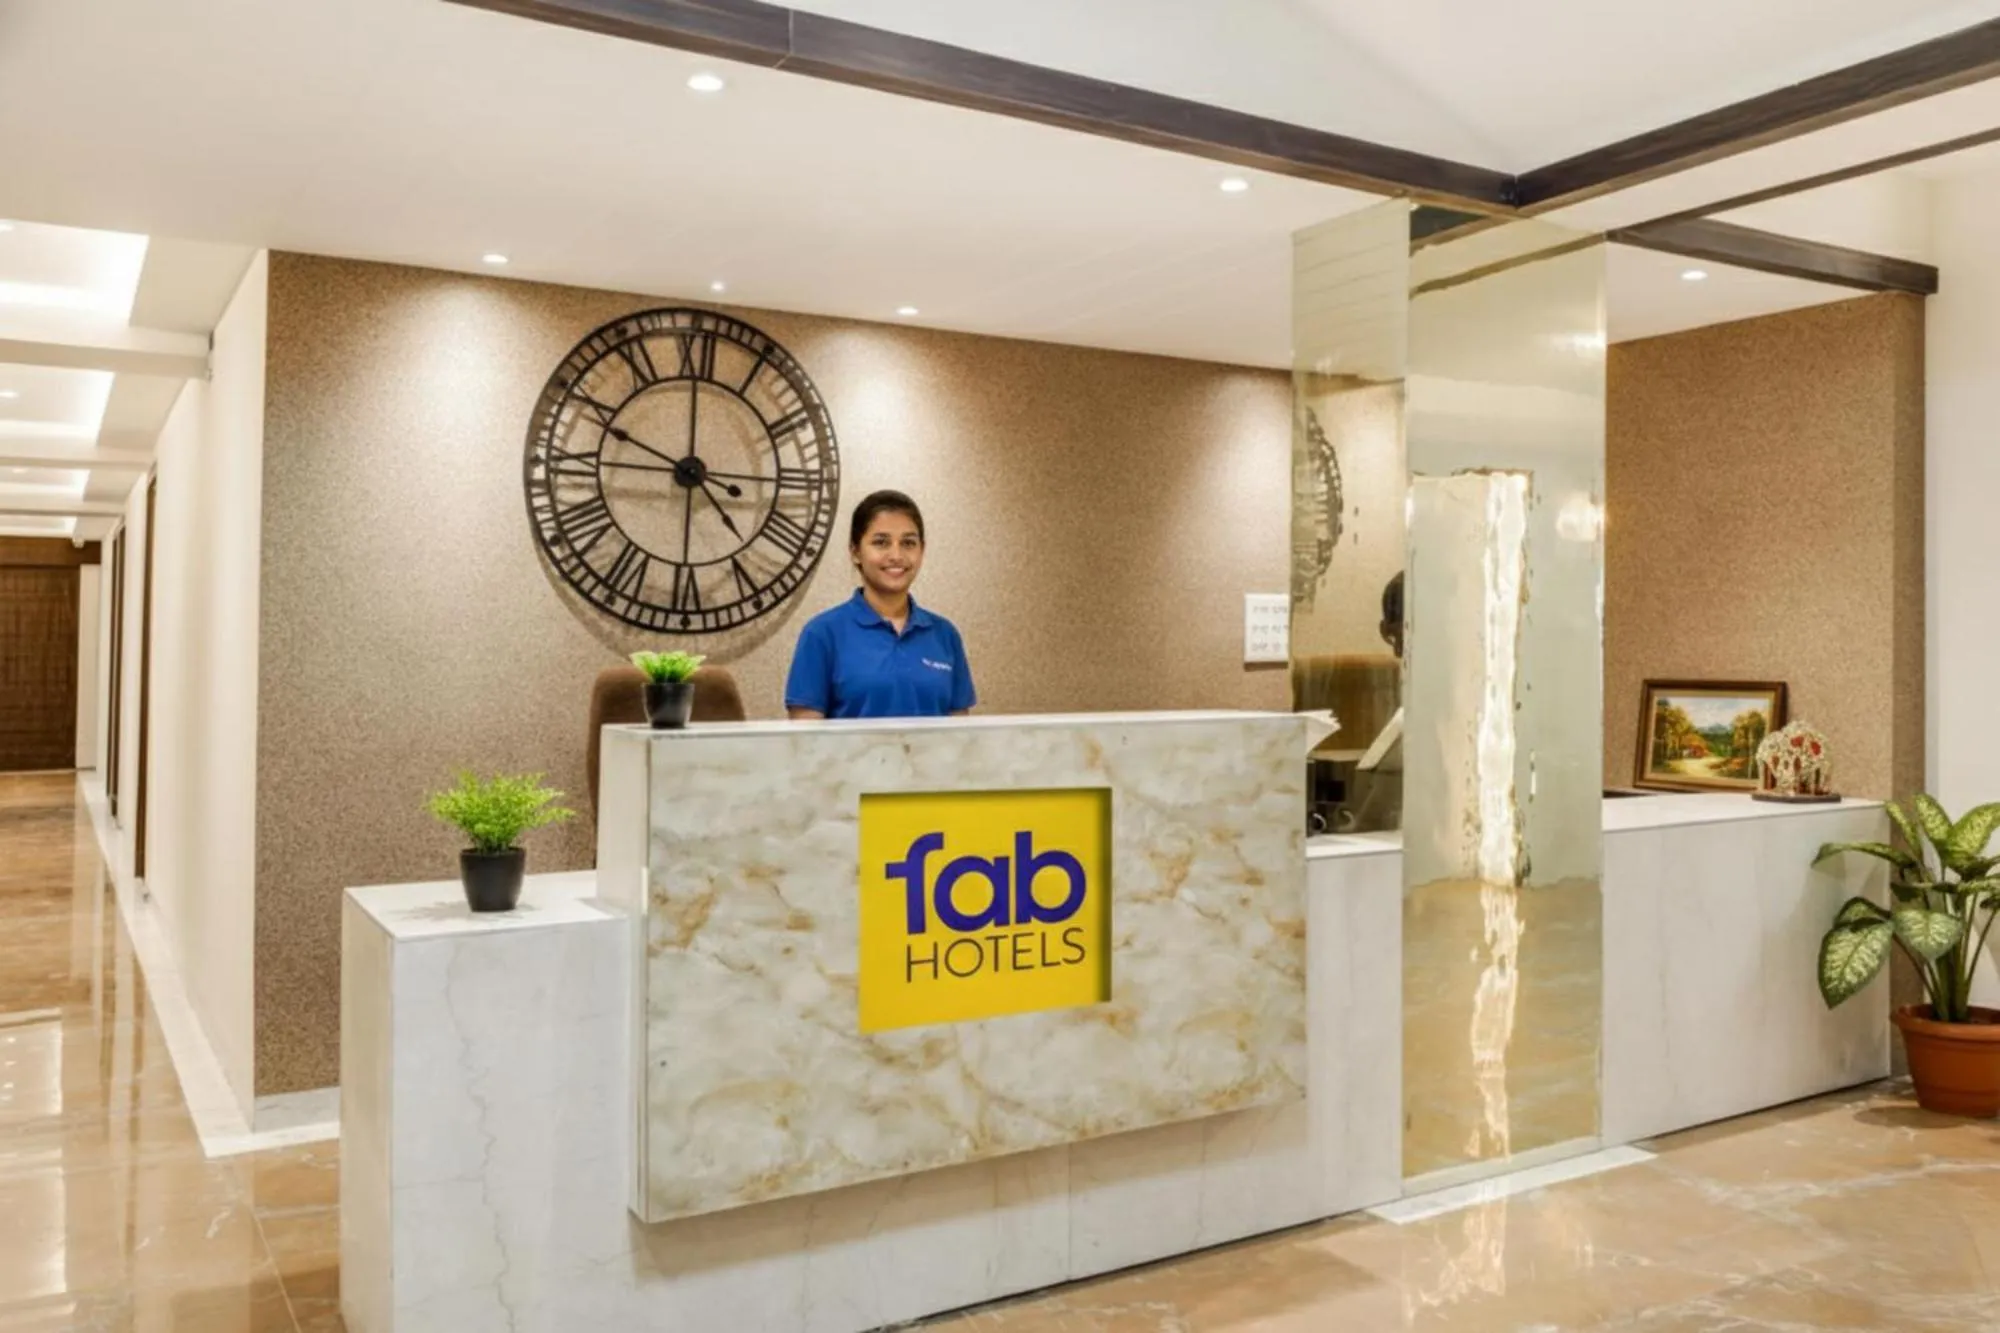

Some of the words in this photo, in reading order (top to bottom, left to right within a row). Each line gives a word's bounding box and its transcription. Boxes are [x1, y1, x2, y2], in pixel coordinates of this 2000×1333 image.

[616, 338, 660, 392] XI
[678, 331, 717, 380] XII
[564, 380, 617, 427] X
[768, 404, 810, 442] II
[549, 446, 600, 478] IX
[779, 466, 822, 491] III
[602, 540, 650, 602] VII
[672, 565, 701, 610] VI
[730, 555, 762, 600] V
[885, 831, 1087, 935] fab
[906, 927, 1086, 983] HOTELS
